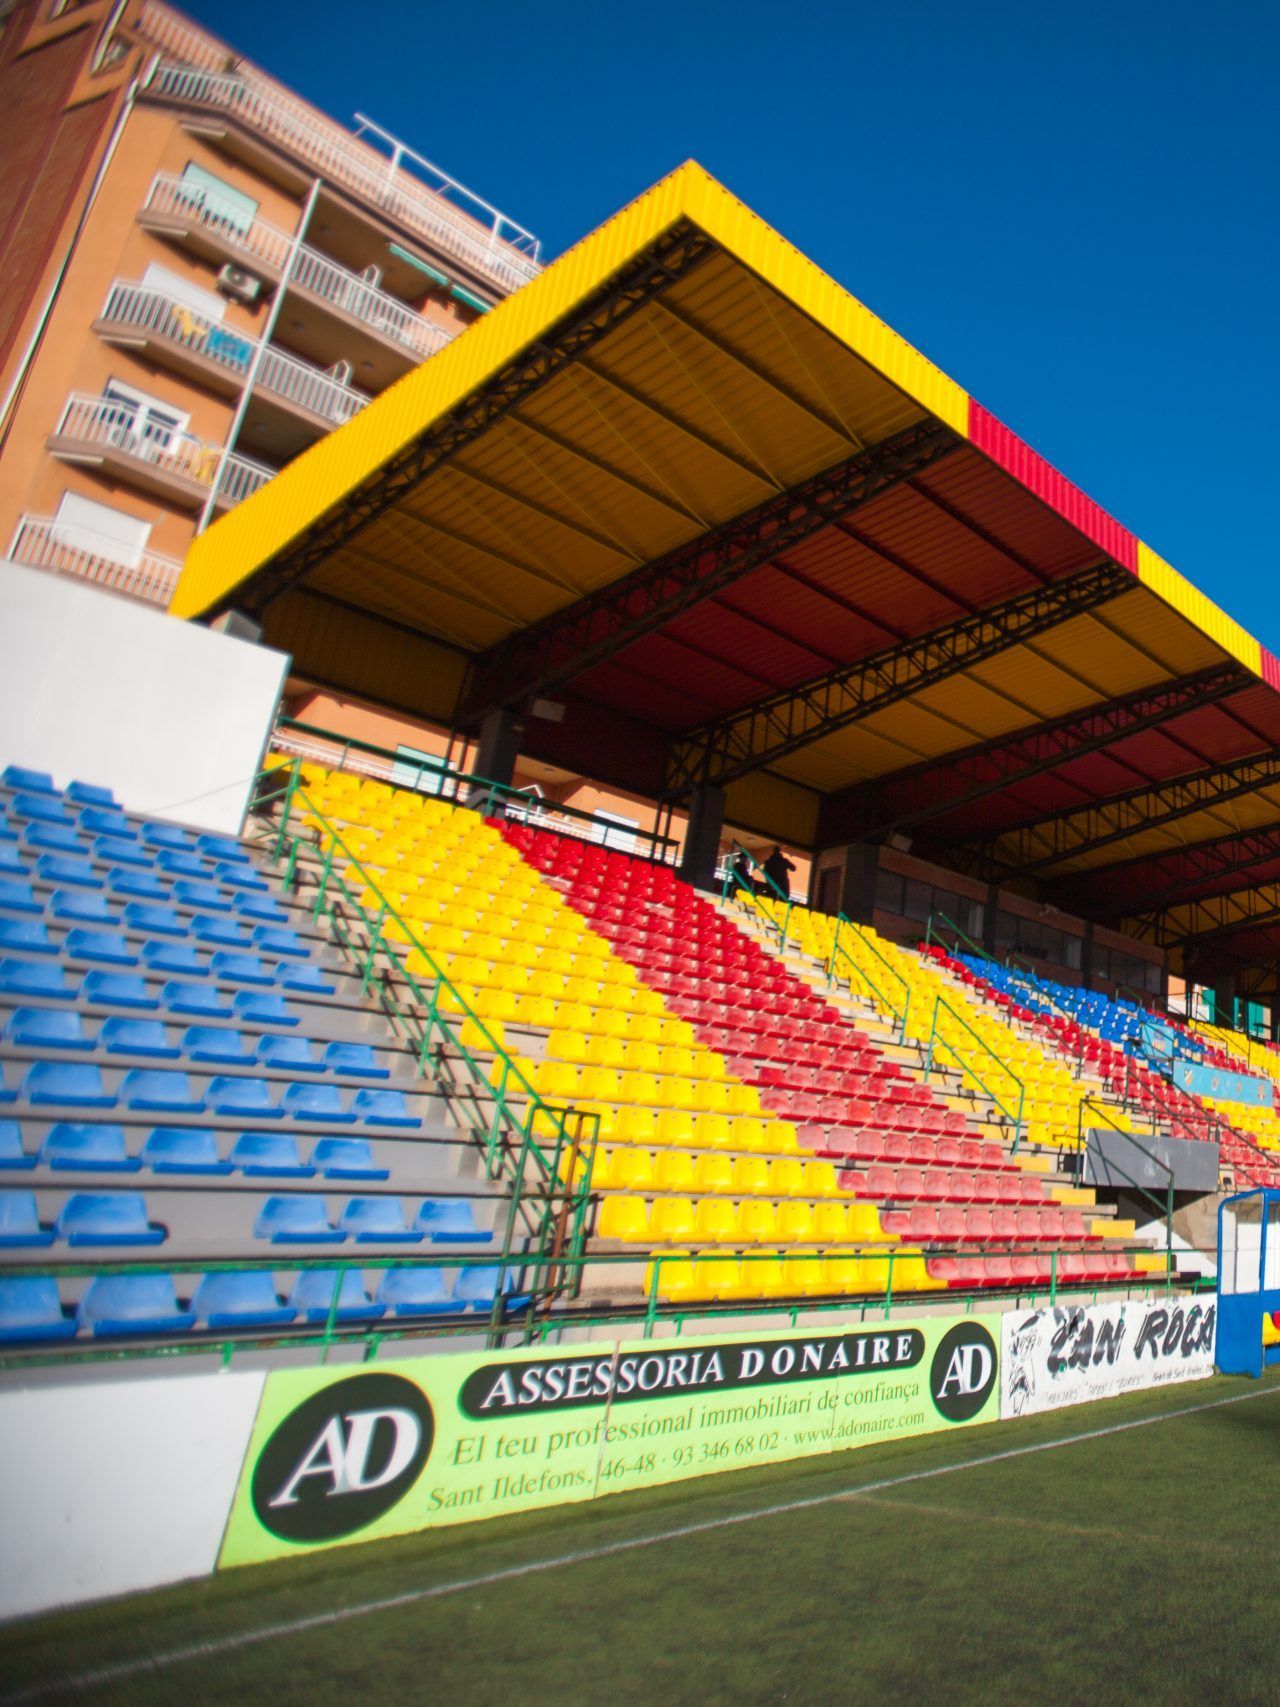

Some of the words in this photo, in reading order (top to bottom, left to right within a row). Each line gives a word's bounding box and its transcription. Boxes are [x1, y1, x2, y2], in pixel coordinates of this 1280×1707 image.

[479, 1352, 725, 1409] ASSESSORIA
[737, 1334, 913, 1380] DONAIRE
[936, 1343, 993, 1399] AD
[1134, 1304, 1216, 1360] ROCA
[267, 1407, 421, 1508] AD
[427, 1483, 484, 1512] Sant
[601, 1453, 656, 1480] 46-48
[672, 1446, 694, 1468] 93
[698, 1440, 730, 1463] 346
[735, 1436, 754, 1456] 68
[759, 1432, 780, 1451] 02
[794, 1410, 926, 1446] www.adonaire.com
[452, 1434, 486, 1466] El
[495, 1435, 538, 1460] teu
[546, 1407, 694, 1460] professional
[700, 1391, 812, 1428] immobiliari
[817, 1389, 840, 1410] de
[844, 1381, 920, 1407] confiança
